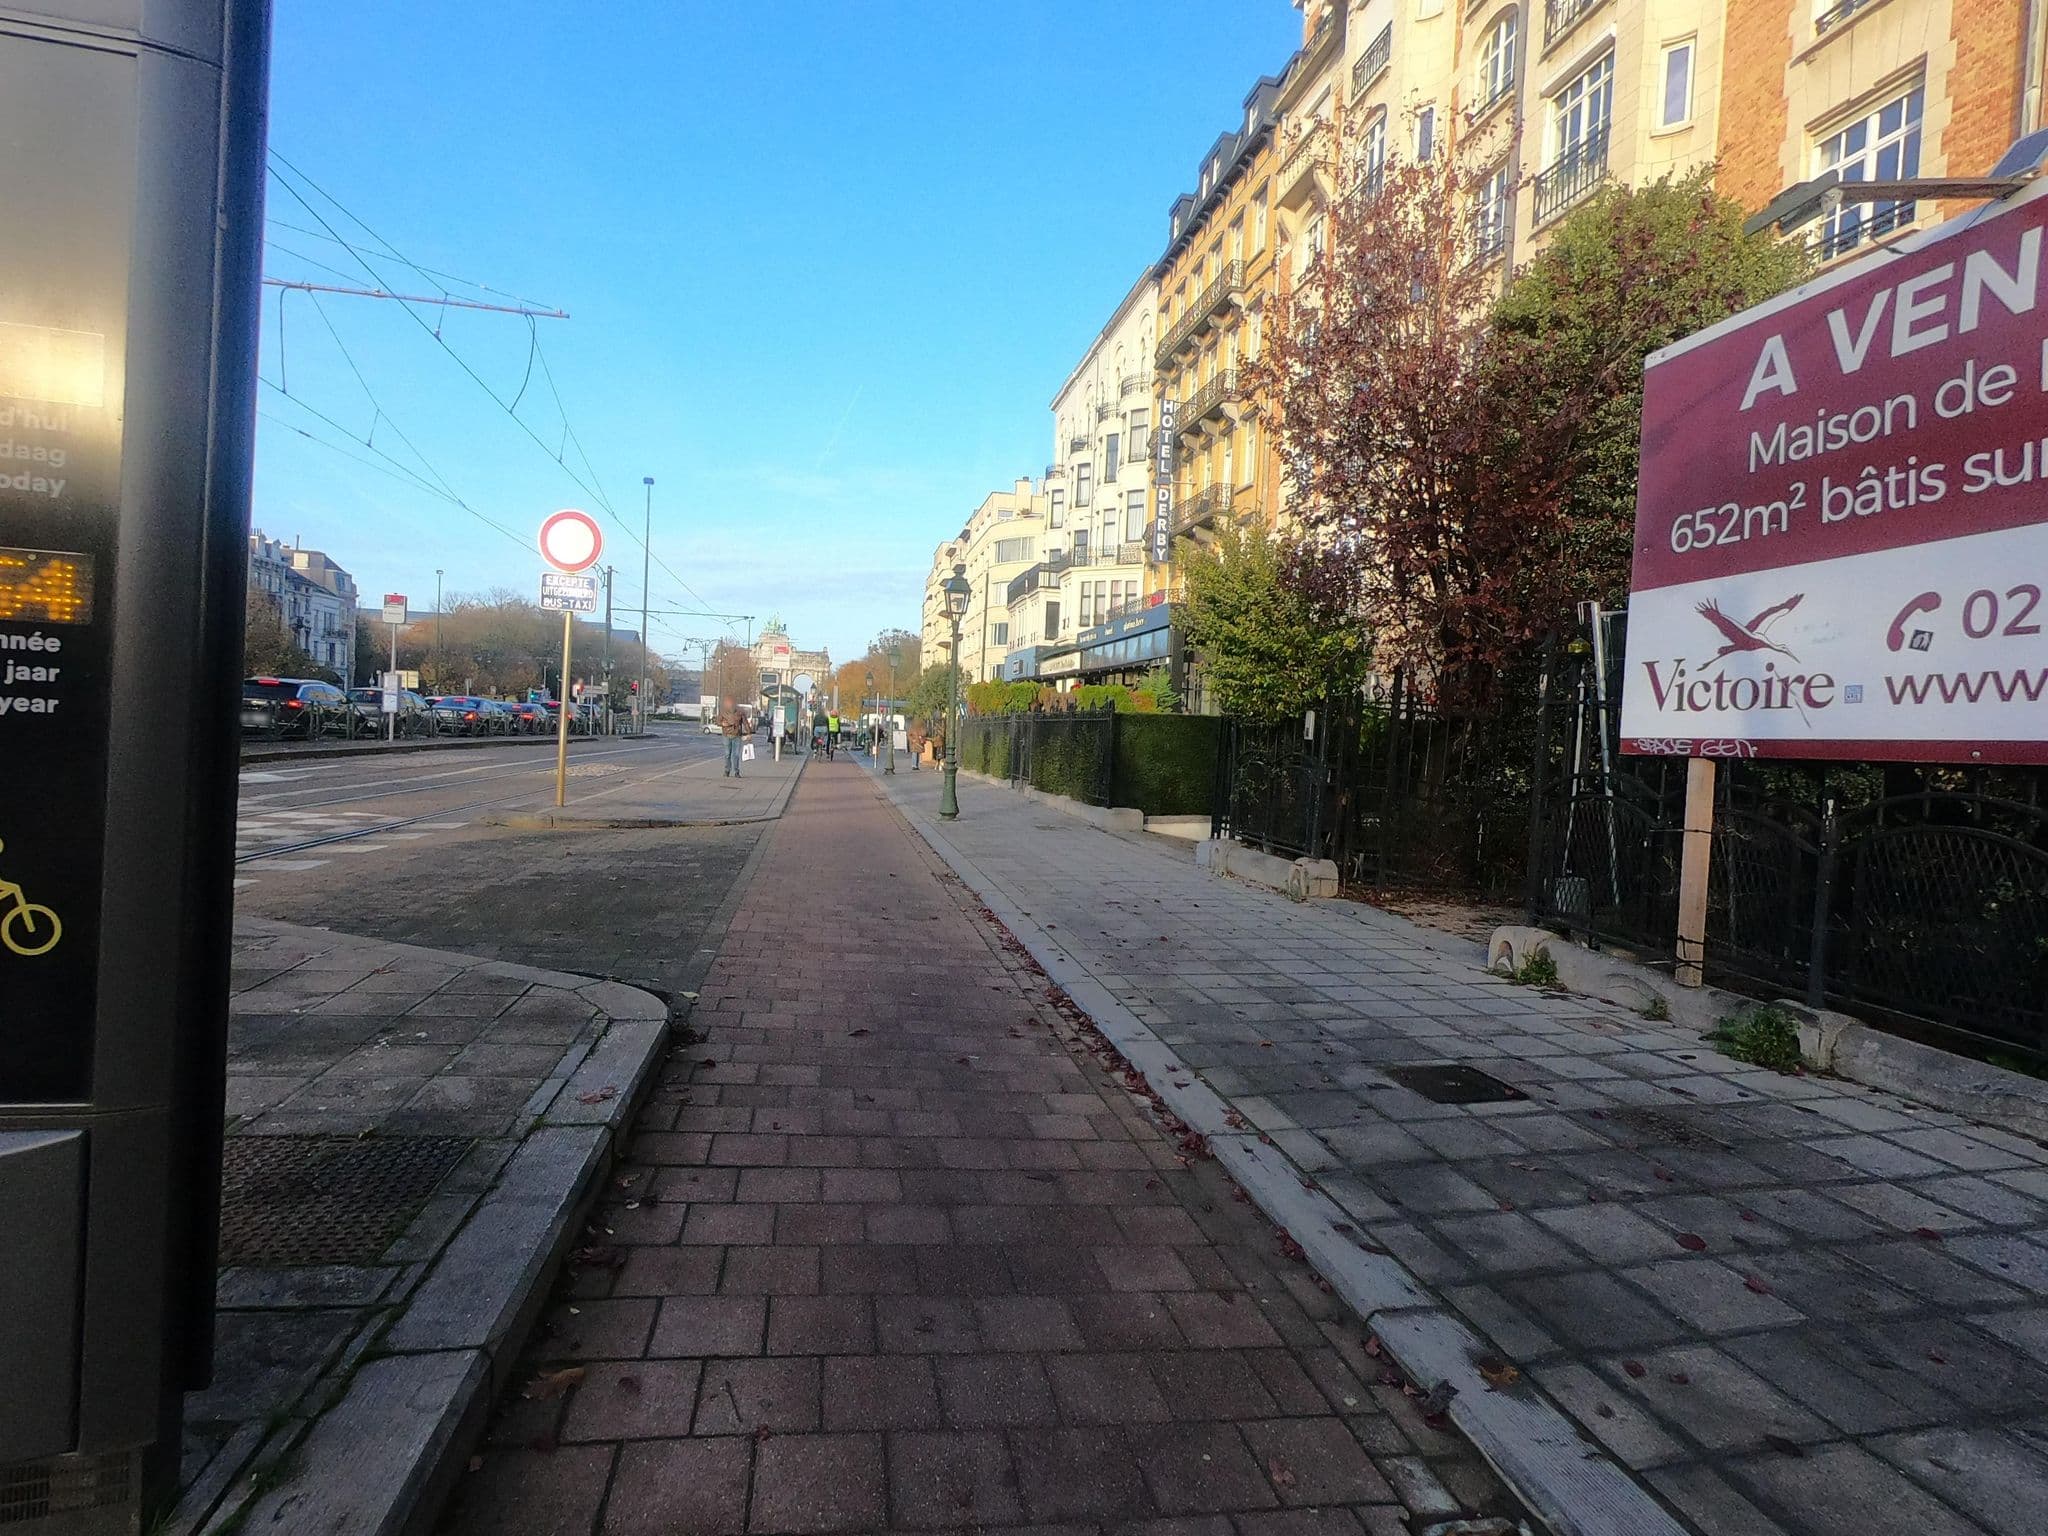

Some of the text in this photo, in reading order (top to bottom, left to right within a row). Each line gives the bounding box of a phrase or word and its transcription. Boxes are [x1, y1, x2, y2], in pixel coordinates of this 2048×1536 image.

[1740, 333, 1798, 411] A
[1826, 225, 2043, 374] VEN
[1749, 393, 1917, 473] Maison
[1934, 359, 2017, 419] de
[1155, 399, 1175, 562] HOTEL DERBY
[1821, 456, 1947, 525] bâtis
[543, 597, 591, 610] BUS-TAXI
[1962, 583, 2041, 639] 02
[4, 659, 60, 685] jaar
[1641, 657, 1835, 713] Victoire
[0, 696, 60, 716] year
